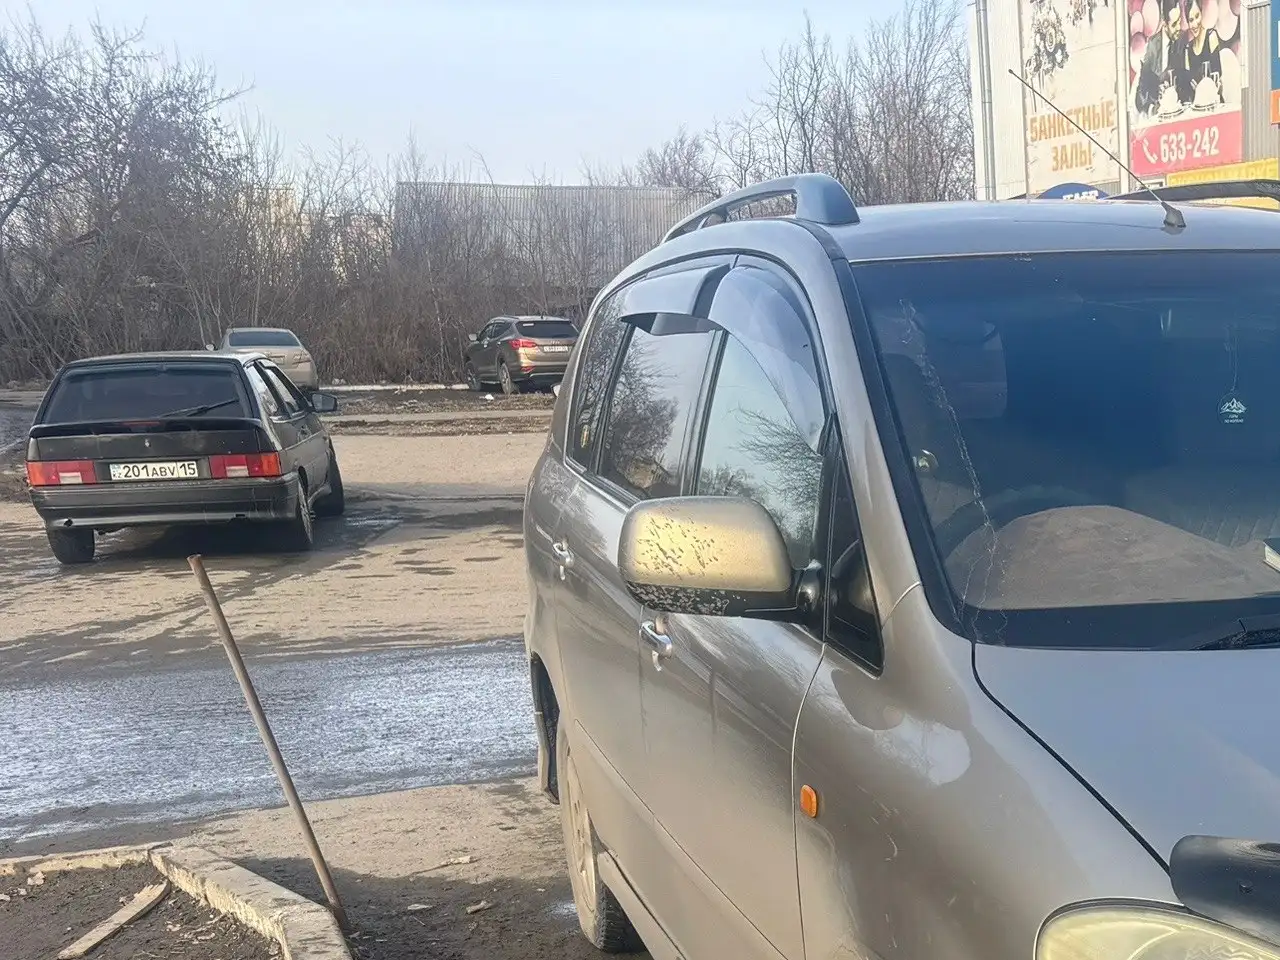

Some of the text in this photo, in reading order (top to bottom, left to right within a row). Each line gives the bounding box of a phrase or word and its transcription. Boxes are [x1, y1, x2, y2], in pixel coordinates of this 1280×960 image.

[1029, 100, 1115, 142] БАНКЕТНЫЕ
[1051, 140, 1093, 172] ЗАЛЫ
[1160, 126, 1220, 163] 633-242
[180, 463, 196, 476] 15
